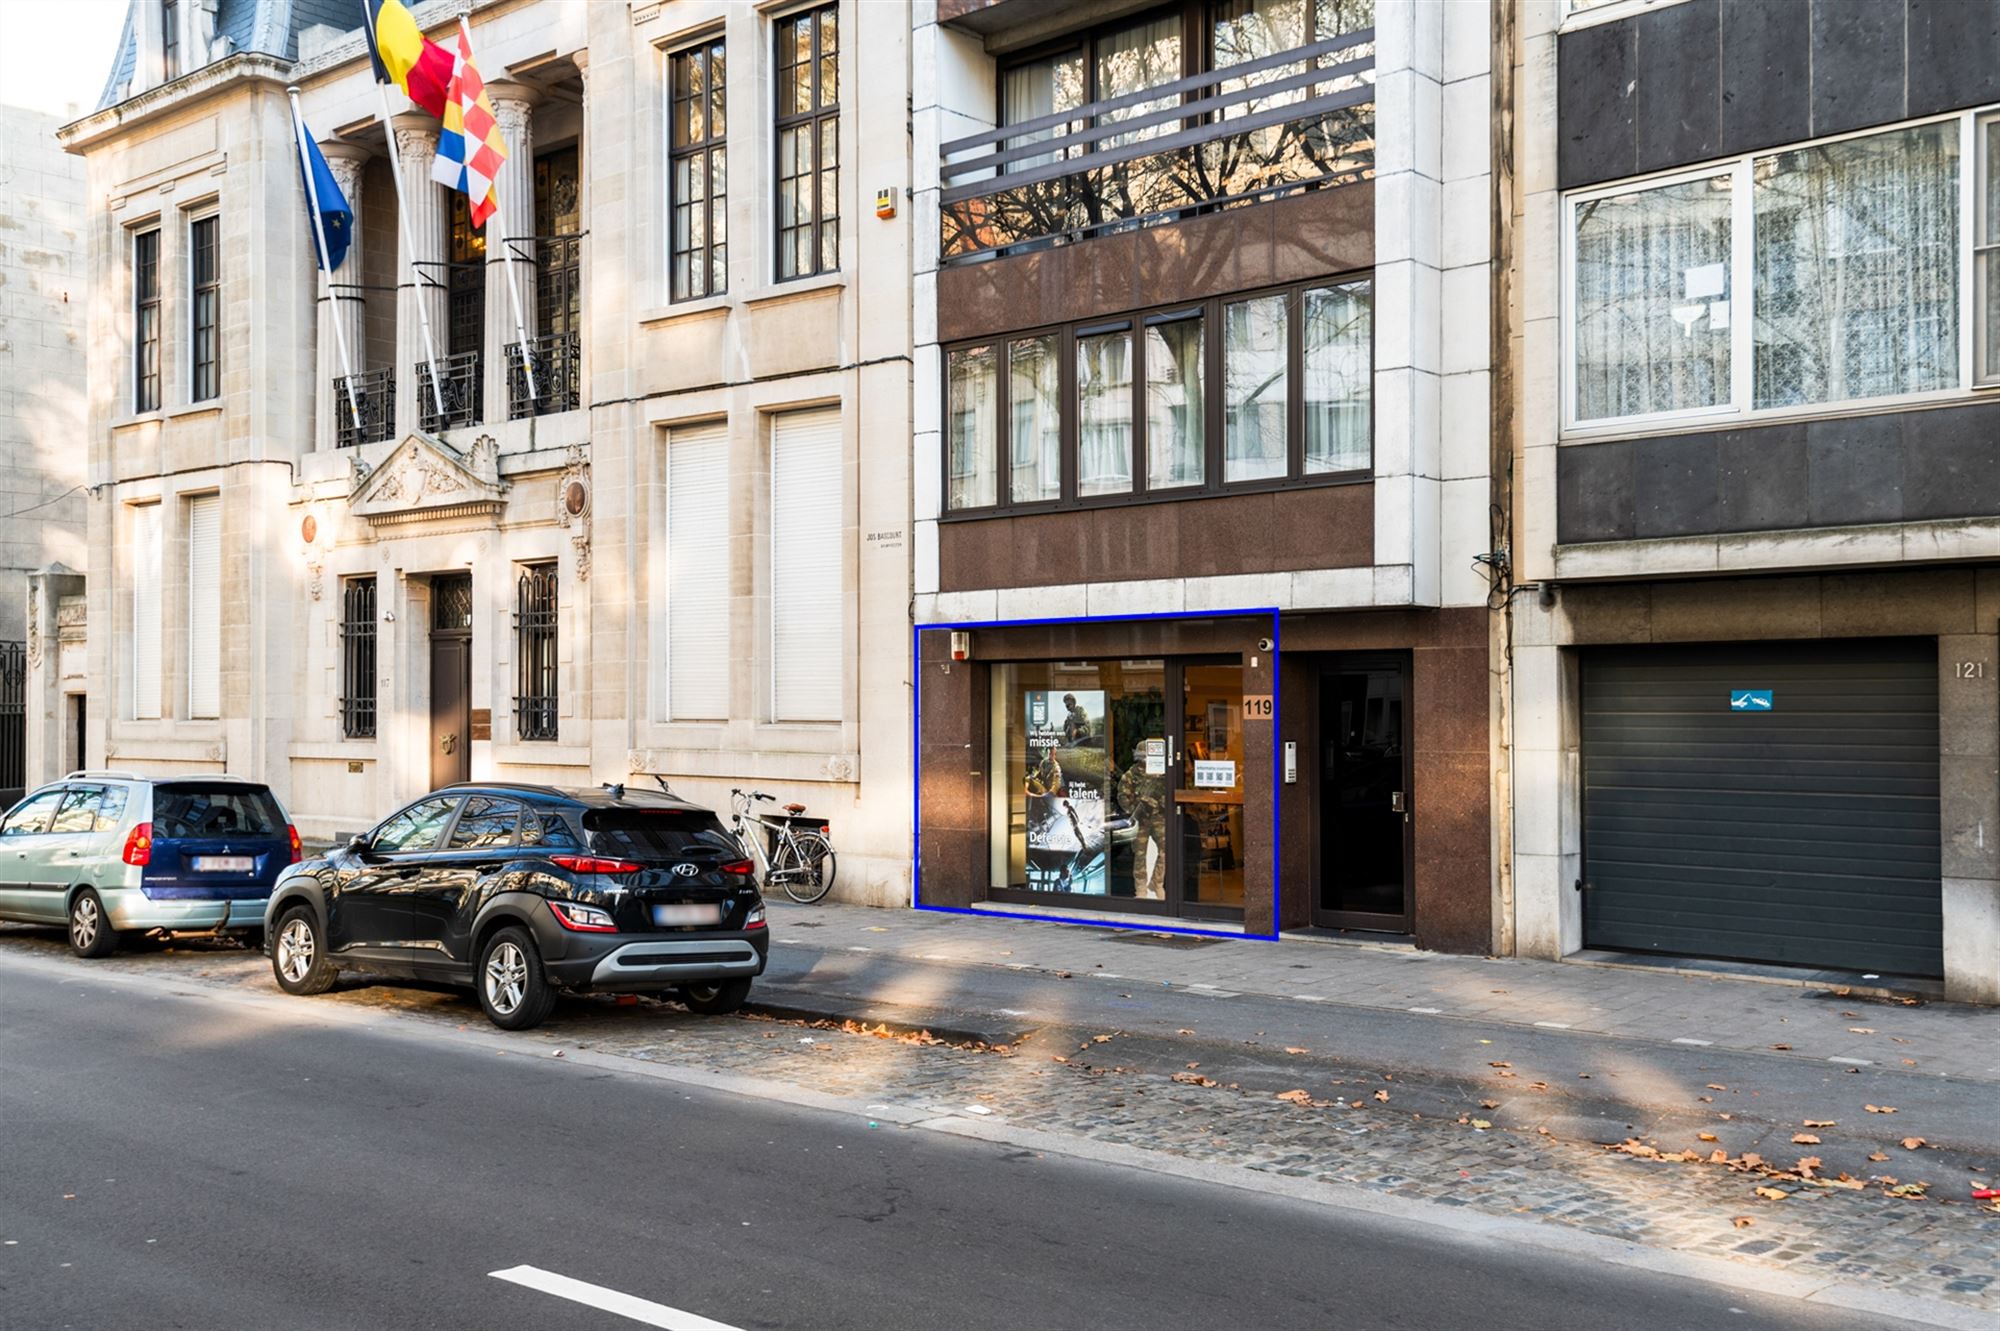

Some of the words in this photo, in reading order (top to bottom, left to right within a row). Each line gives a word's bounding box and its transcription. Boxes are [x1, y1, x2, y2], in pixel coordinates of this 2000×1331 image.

[1956, 662, 1982, 678] 121
[1245, 699, 1272, 715] 119
[1029, 736, 1061, 747] missie.
[1069, 787, 1100, 799] talent.
